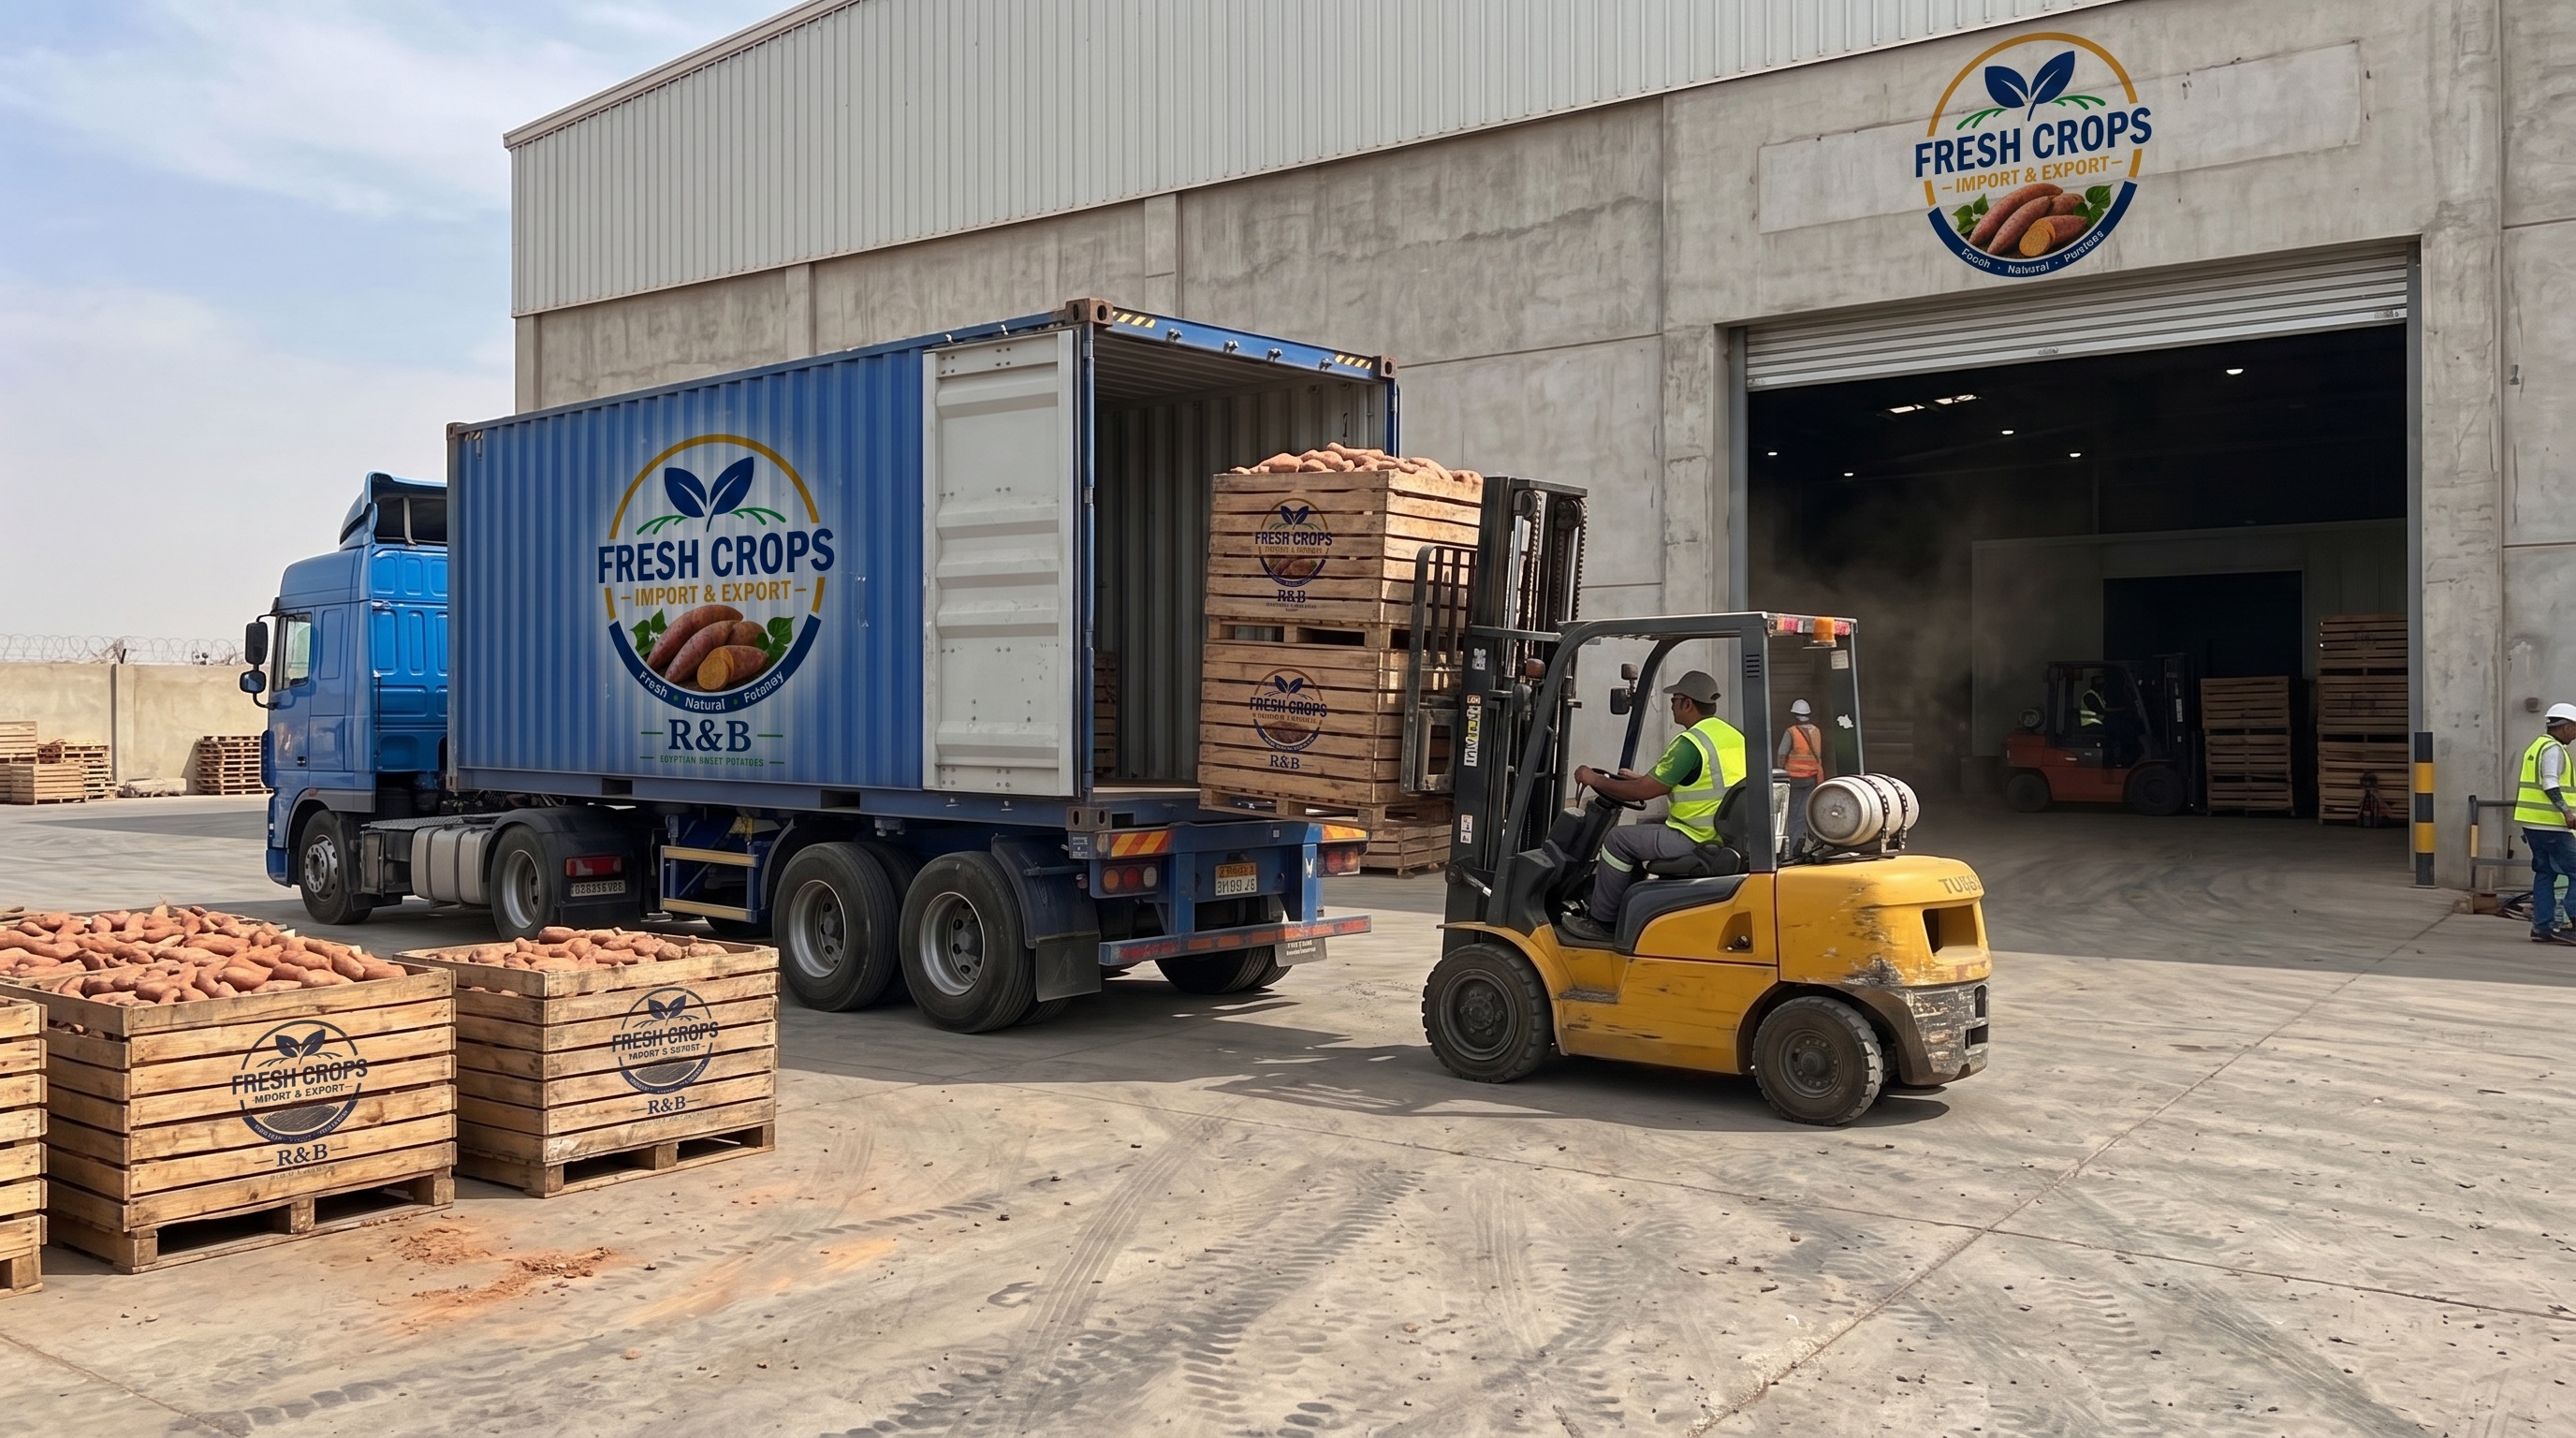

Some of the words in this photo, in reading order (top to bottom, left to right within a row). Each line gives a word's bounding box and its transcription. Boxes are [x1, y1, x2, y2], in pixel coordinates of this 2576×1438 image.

[1915, 127, 2021, 178] FRESH
[2032, 107, 2153, 160] CROPS
[1955, 169, 2020, 193] IMPORT
[2024, 167, 2037, 183] &
[2042, 155, 2110, 181] EXPORT
[1293, 532, 1333, 546] CROPS
[597, 538, 699, 584] FRESH
[710, 528, 835, 578] CROPS
[635, 585, 698, 607] IMPORT
[703, 584, 716, 603] &
[722, 580, 791, 602] EXPORT
[1277, 590, 1306, 603] R&B
[639, 670, 668, 698] Fresh
[684, 697, 725, 711] Natural
[1249, 697, 1285, 713] FRESH
[1288, 700, 1327, 717] CROPS
[668, 719, 752, 753] R&B
[660, 755, 696, 764] EGYPTIAN
[725, 757, 764, 767] POTATOES
[1269, 755, 1300, 770] R&B
[612, 1029, 663, 1053] FRESH
[667, 1021, 719, 1044] CROPS
[232, 1067, 297, 1095] FRESH
[302, 1059, 368, 1085] CROPS
[294, 1090, 301, 1098] &
[305, 1083, 345, 1096] EXPORT
[648, 1095, 686, 1115] R&B
[276, 1143, 328, 1167] R&B
